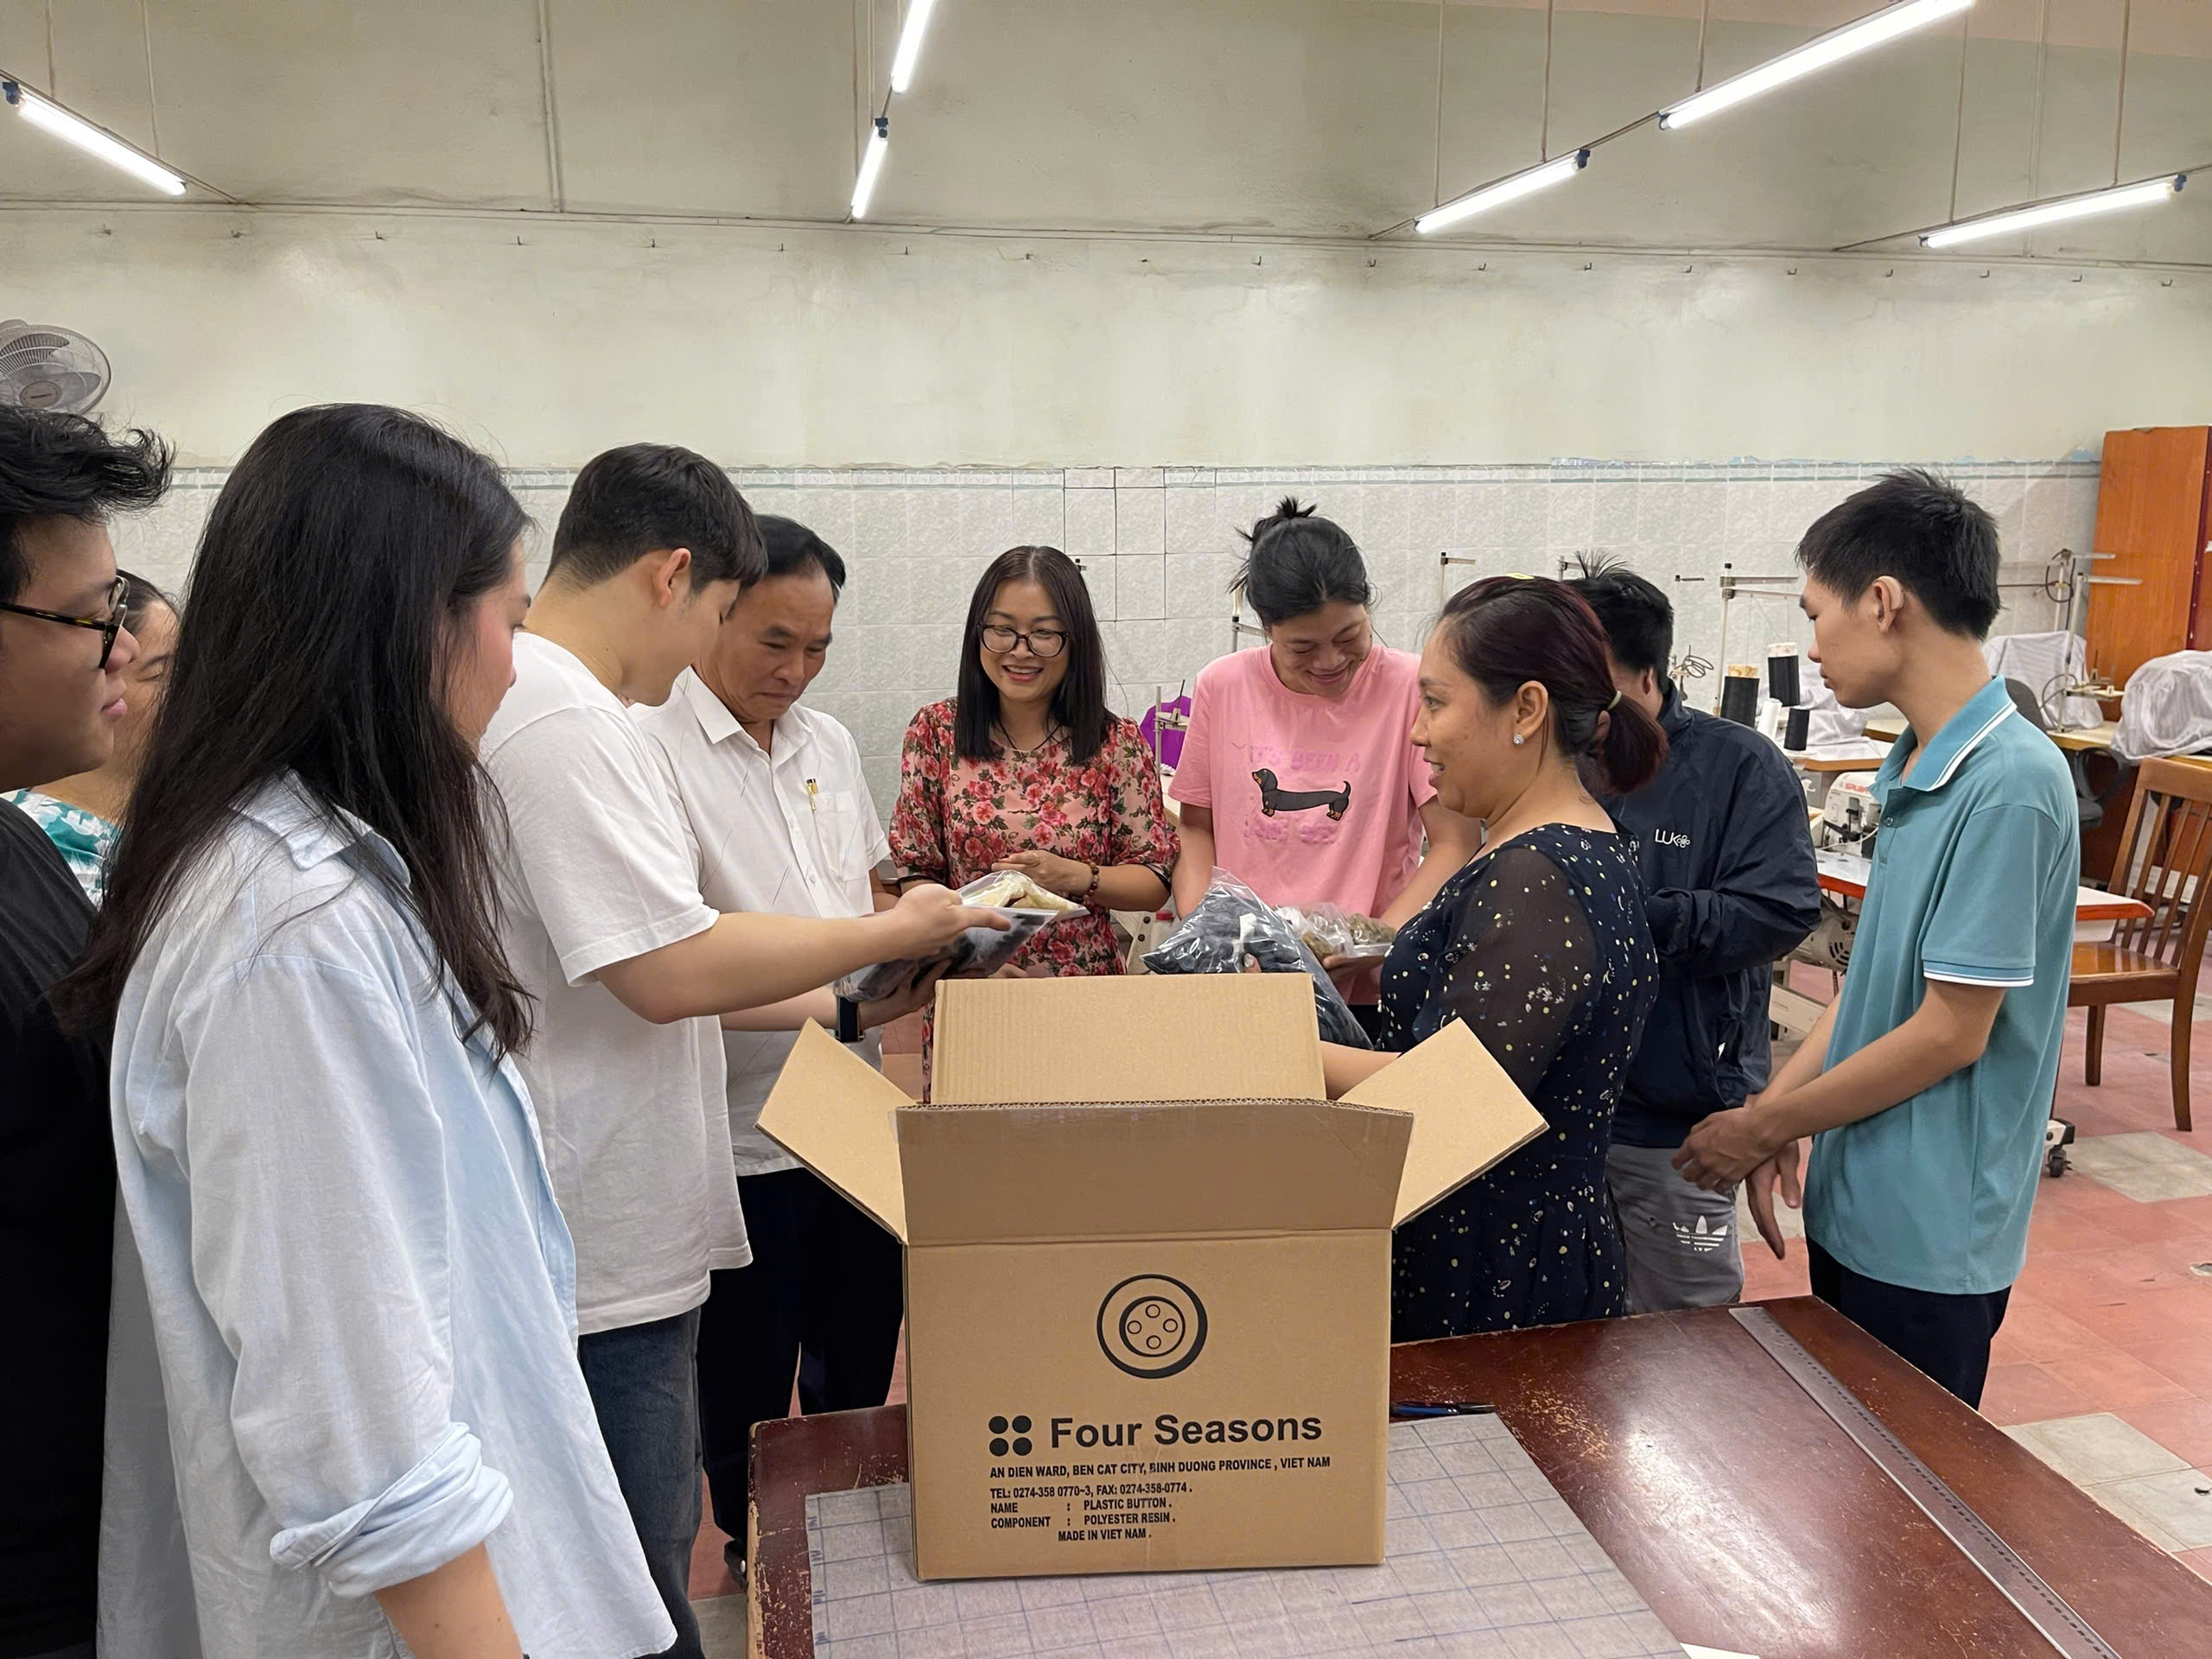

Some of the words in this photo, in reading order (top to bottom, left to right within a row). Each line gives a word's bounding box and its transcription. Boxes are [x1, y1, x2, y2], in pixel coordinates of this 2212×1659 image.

[1051, 1417, 1142, 1448] Four
[1154, 1414, 1322, 1445] Seasons
[989, 1467, 1005, 1478] AN
[1007, 1466, 1033, 1478] DIEN
[1035, 1465, 1070, 1478] WARD,
[1072, 1465, 1094, 1476] BEN
[1096, 1464, 1117, 1474] CAT
[1120, 1462, 1147, 1475] CITY,
[1149, 1462, 1175, 1473] BINH
[1178, 1460, 1216, 1472] DUONG
[1218, 1459, 1272, 1471] PROVINCE
[1280, 1458, 1305, 1469] VIET
[1306, 1456, 1331, 1467] NAM
[990, 1488, 1011, 1498] TEL:
[1014, 1486, 1055, 1498] 0274-358
[1096, 1484, 1117, 1496] FAX:
[1120, 1482, 1187, 1495] 0274-358-0774
[990, 1503, 1018, 1514] NAME
[1084, 1498, 1124, 1510] PLASTIC
[1127, 1497, 1166, 1509] BUTTON
[991, 1516, 1051, 1529] COMPONENT
[1084, 1513, 1139, 1525] POLYESTER
[1141, 1512, 1170, 1523] RESIN
[1058, 1530, 1085, 1541] MADE
[1088, 1529, 1098, 1540] IN
[1101, 1529, 1122, 1540] VIET
[1125, 1528, 1147, 1539] NAM
